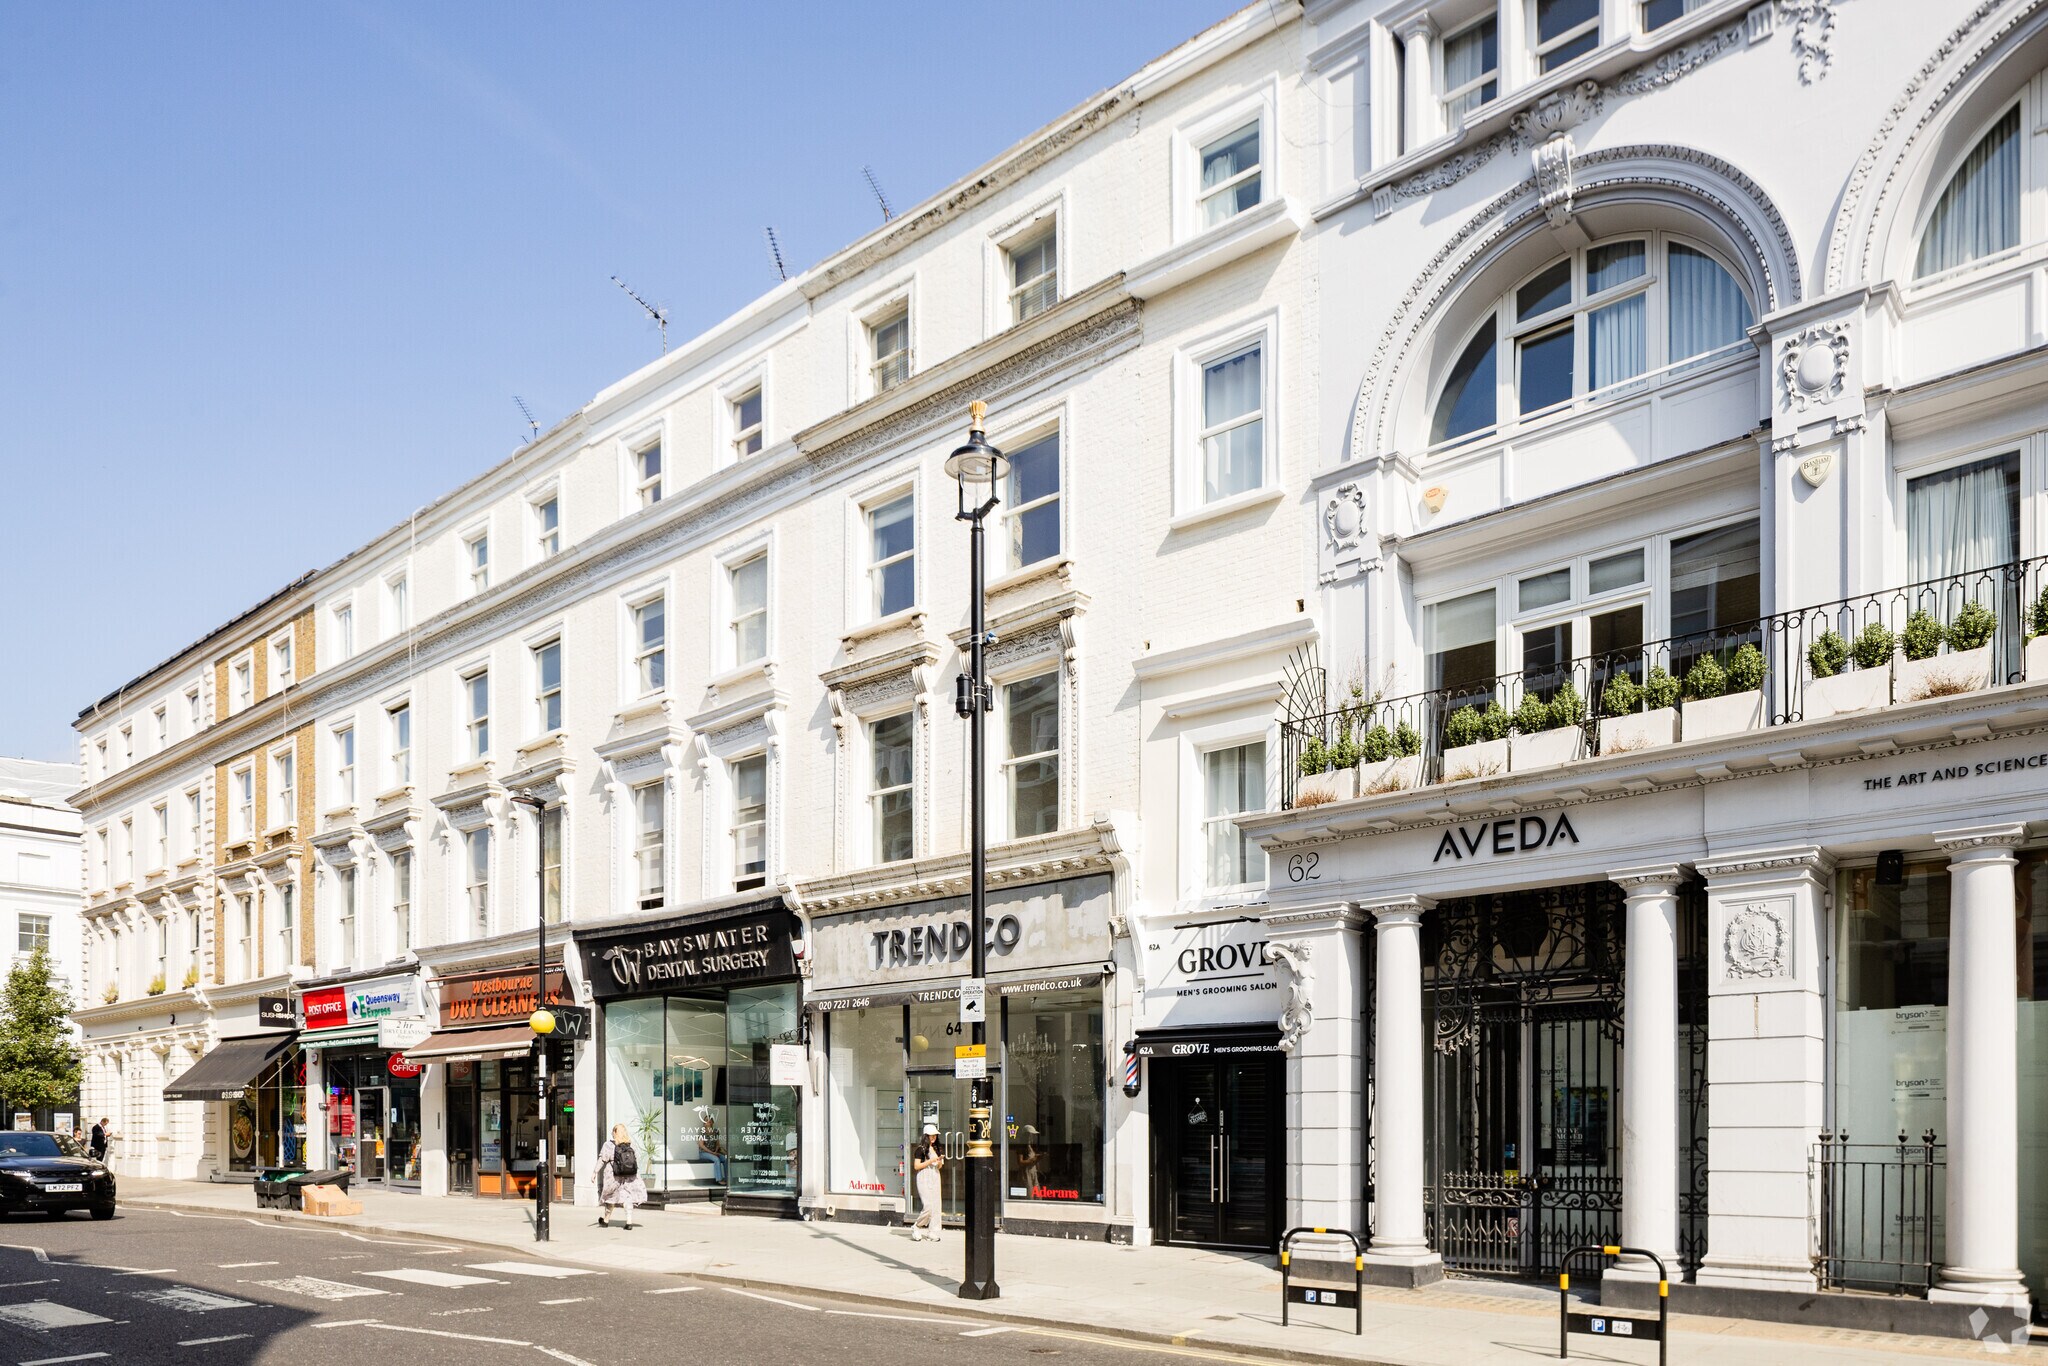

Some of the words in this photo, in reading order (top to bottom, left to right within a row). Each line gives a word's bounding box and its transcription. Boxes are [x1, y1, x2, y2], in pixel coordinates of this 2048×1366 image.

[1864, 777, 1892, 790] THE
[1897, 772, 1927, 787] ART
[1932, 766, 1969, 781] AND
[1975, 754, 2048, 776] SCIENCE
[1433, 812, 1580, 862] AVEDA
[1288, 852, 1322, 882] 62
[644, 925, 769, 958] BAYSWATER
[647, 959, 700, 981] DENTAL
[702, 949, 770, 974] SURGERY
[472, 976, 533, 995] Westbourne
[1001, 976, 1082, 994] www.trendco.co.uk
[1176, 989, 1200, 997] MEN'S
[1203, 984, 1248, 995] GROOMING
[1250, 982, 1277, 991] SALON
[365, 992, 400, 1005] Queensway
[918, 989, 961, 1002] TRENDCO
[308, 1004, 322, 1015] POST
[322, 1001, 342, 1013] OFFICE
[450, 997, 479, 1020] DRY
[819, 1001, 832, 1011] 020
[834, 1000, 851, 1010] 7221
[852, 998, 870, 1008] 2646
[366, 1007, 391, 1018] Express
[1895, 1012, 1925, 1020] bryson
[396, 1021, 402, 1029] 2
[402, 1021, 414, 1030] hr
[946, 1022, 962, 1035] 64
[1139, 1046, 1154, 1055] 62A
[1172, 1043, 1210, 1055] GROVE
[1213, 1046, 1232, 1054] MEN'S
[1232, 1045, 1262, 1053] GROOMING
[391, 1063, 419, 1073] OFFICE
[1895, 1079, 1925, 1087] bryson
[1895, 1146, 1925, 1155] byson
[849, 1180, 885, 1191] Aderans
[1031, 1186, 1079, 1199] Aderans
[1307, 1290, 1315, 1301] P
[1594, 1319, 1603, 1331] P
